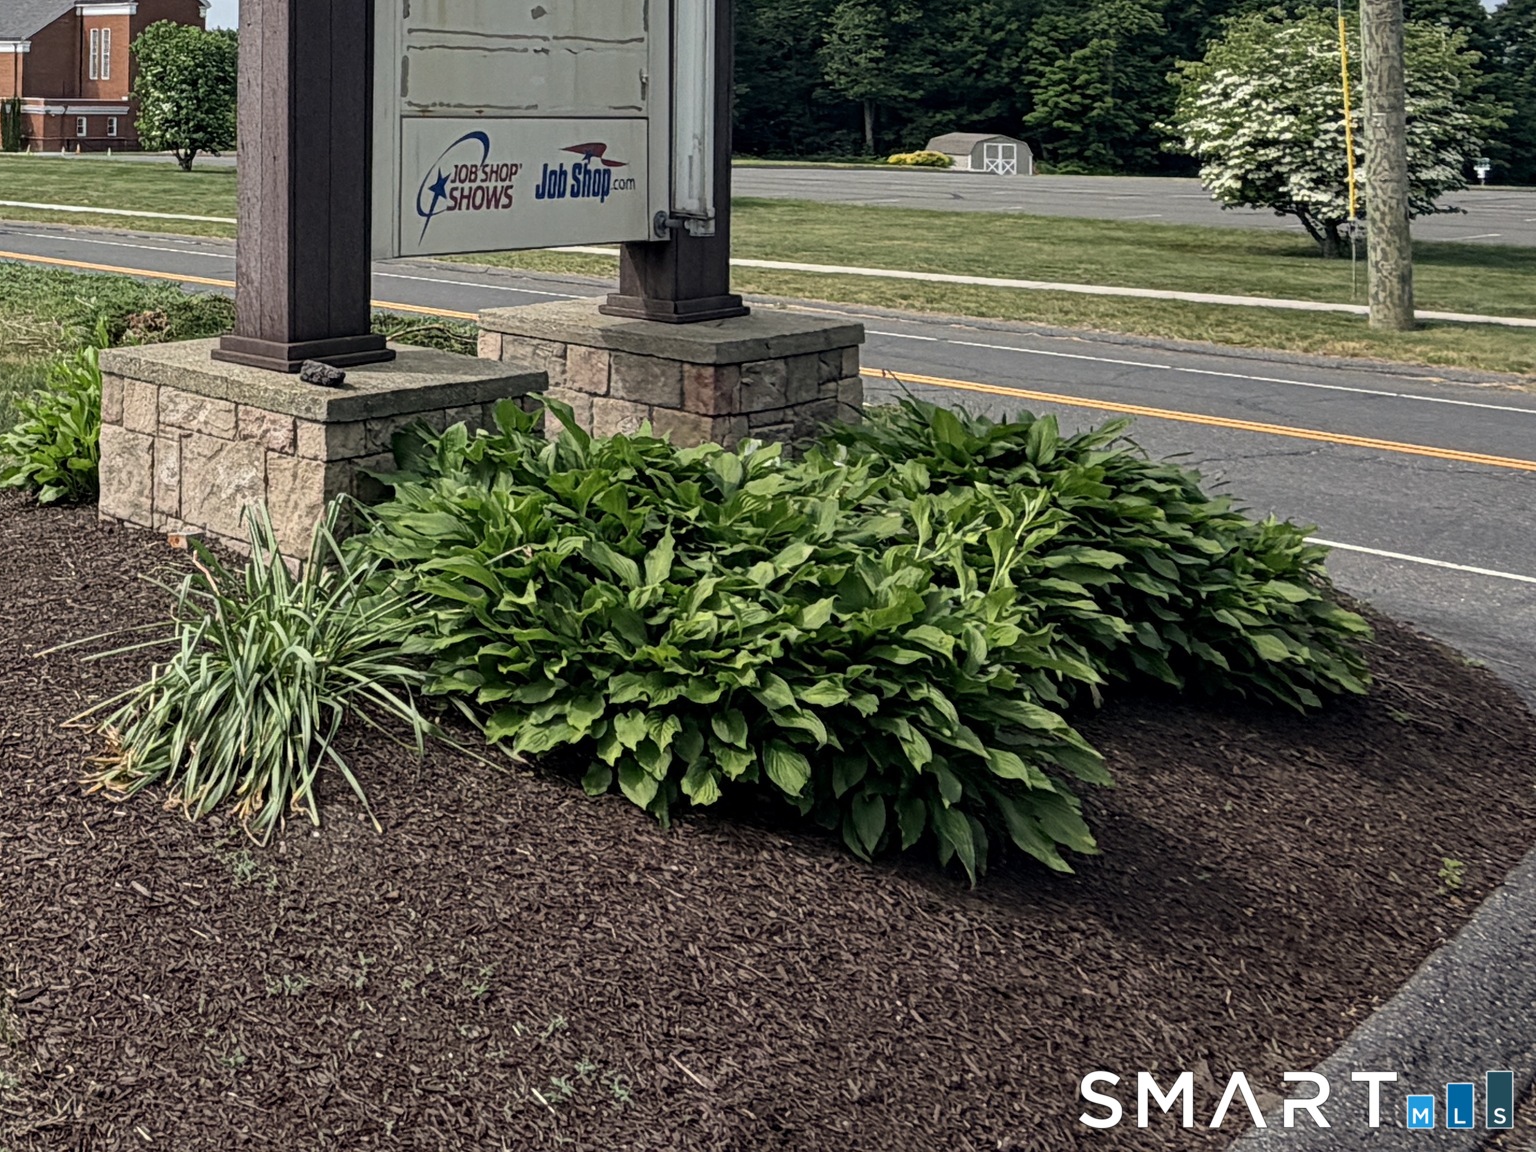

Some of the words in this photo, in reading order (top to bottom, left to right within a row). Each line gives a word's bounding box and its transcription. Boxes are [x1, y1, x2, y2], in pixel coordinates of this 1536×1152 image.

[450, 163, 478, 184] JOB
[535, 163, 566, 200] Job
[446, 184, 514, 211] SHOWS
